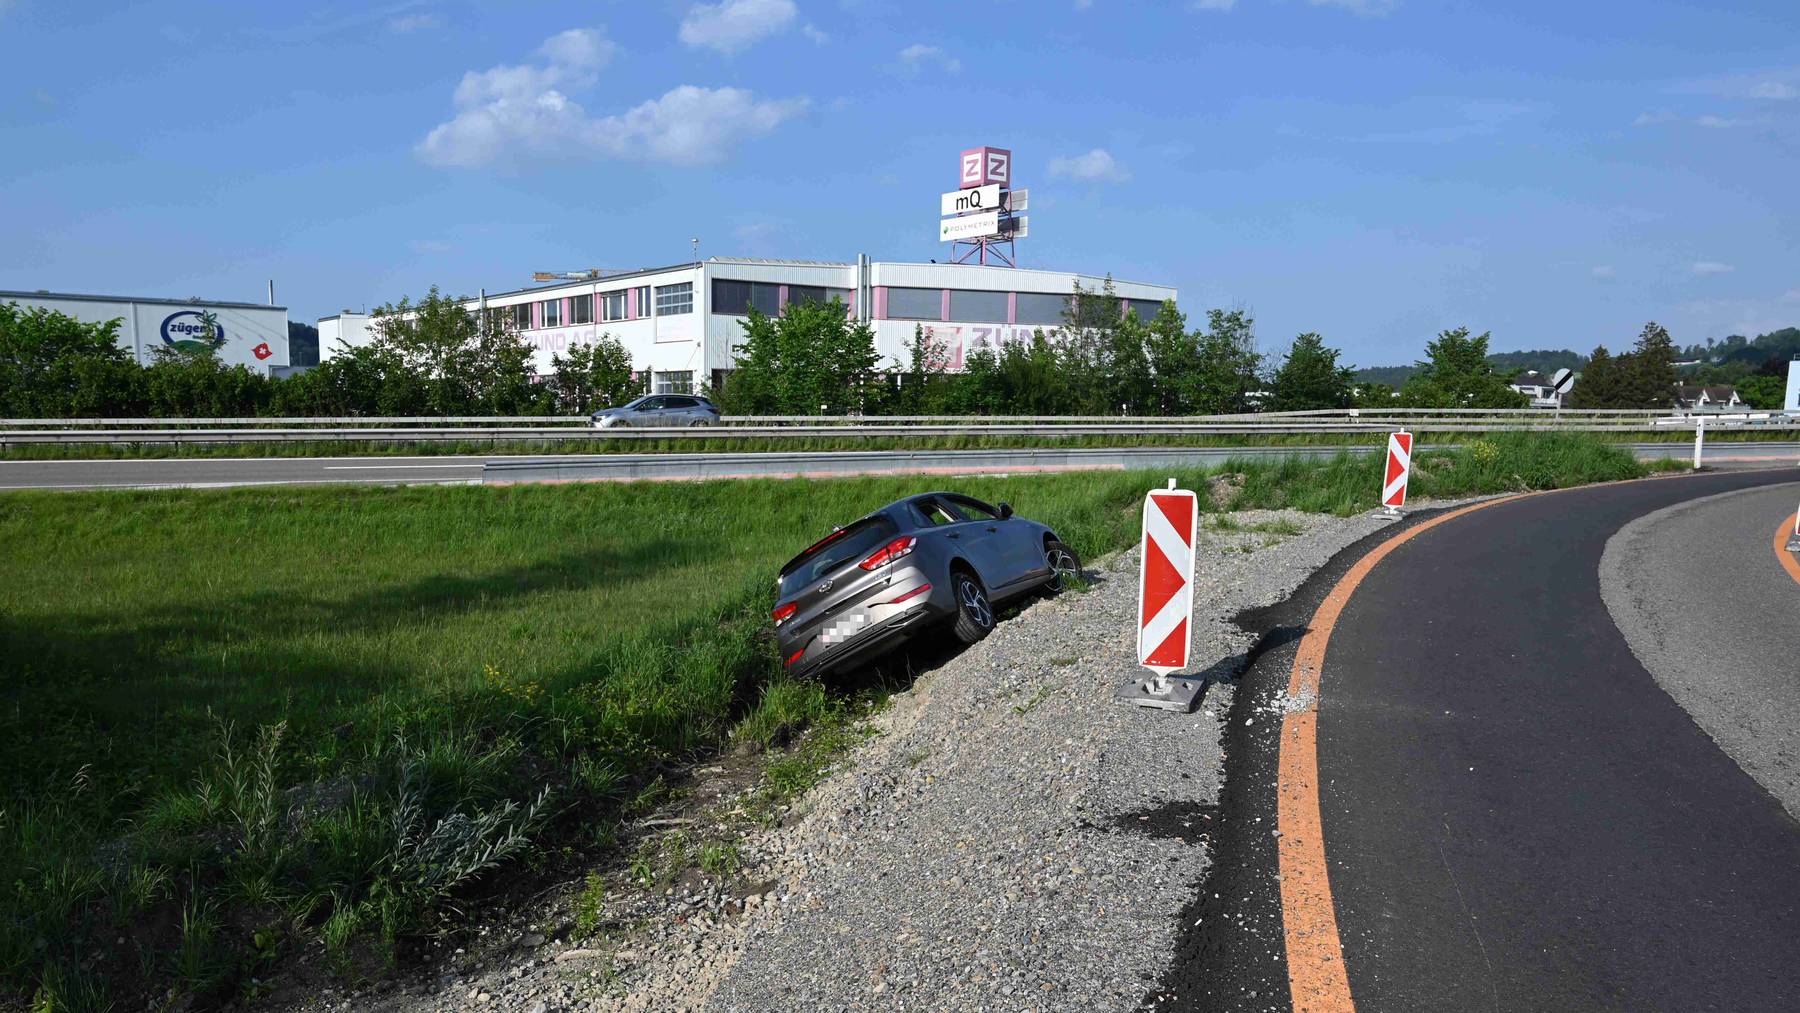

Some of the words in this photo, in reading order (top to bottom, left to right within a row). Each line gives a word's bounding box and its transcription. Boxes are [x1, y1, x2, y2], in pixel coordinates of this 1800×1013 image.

[965, 158, 980, 178] Z
[990, 157, 1006, 177] Z
[955, 190, 983, 210] mQ
